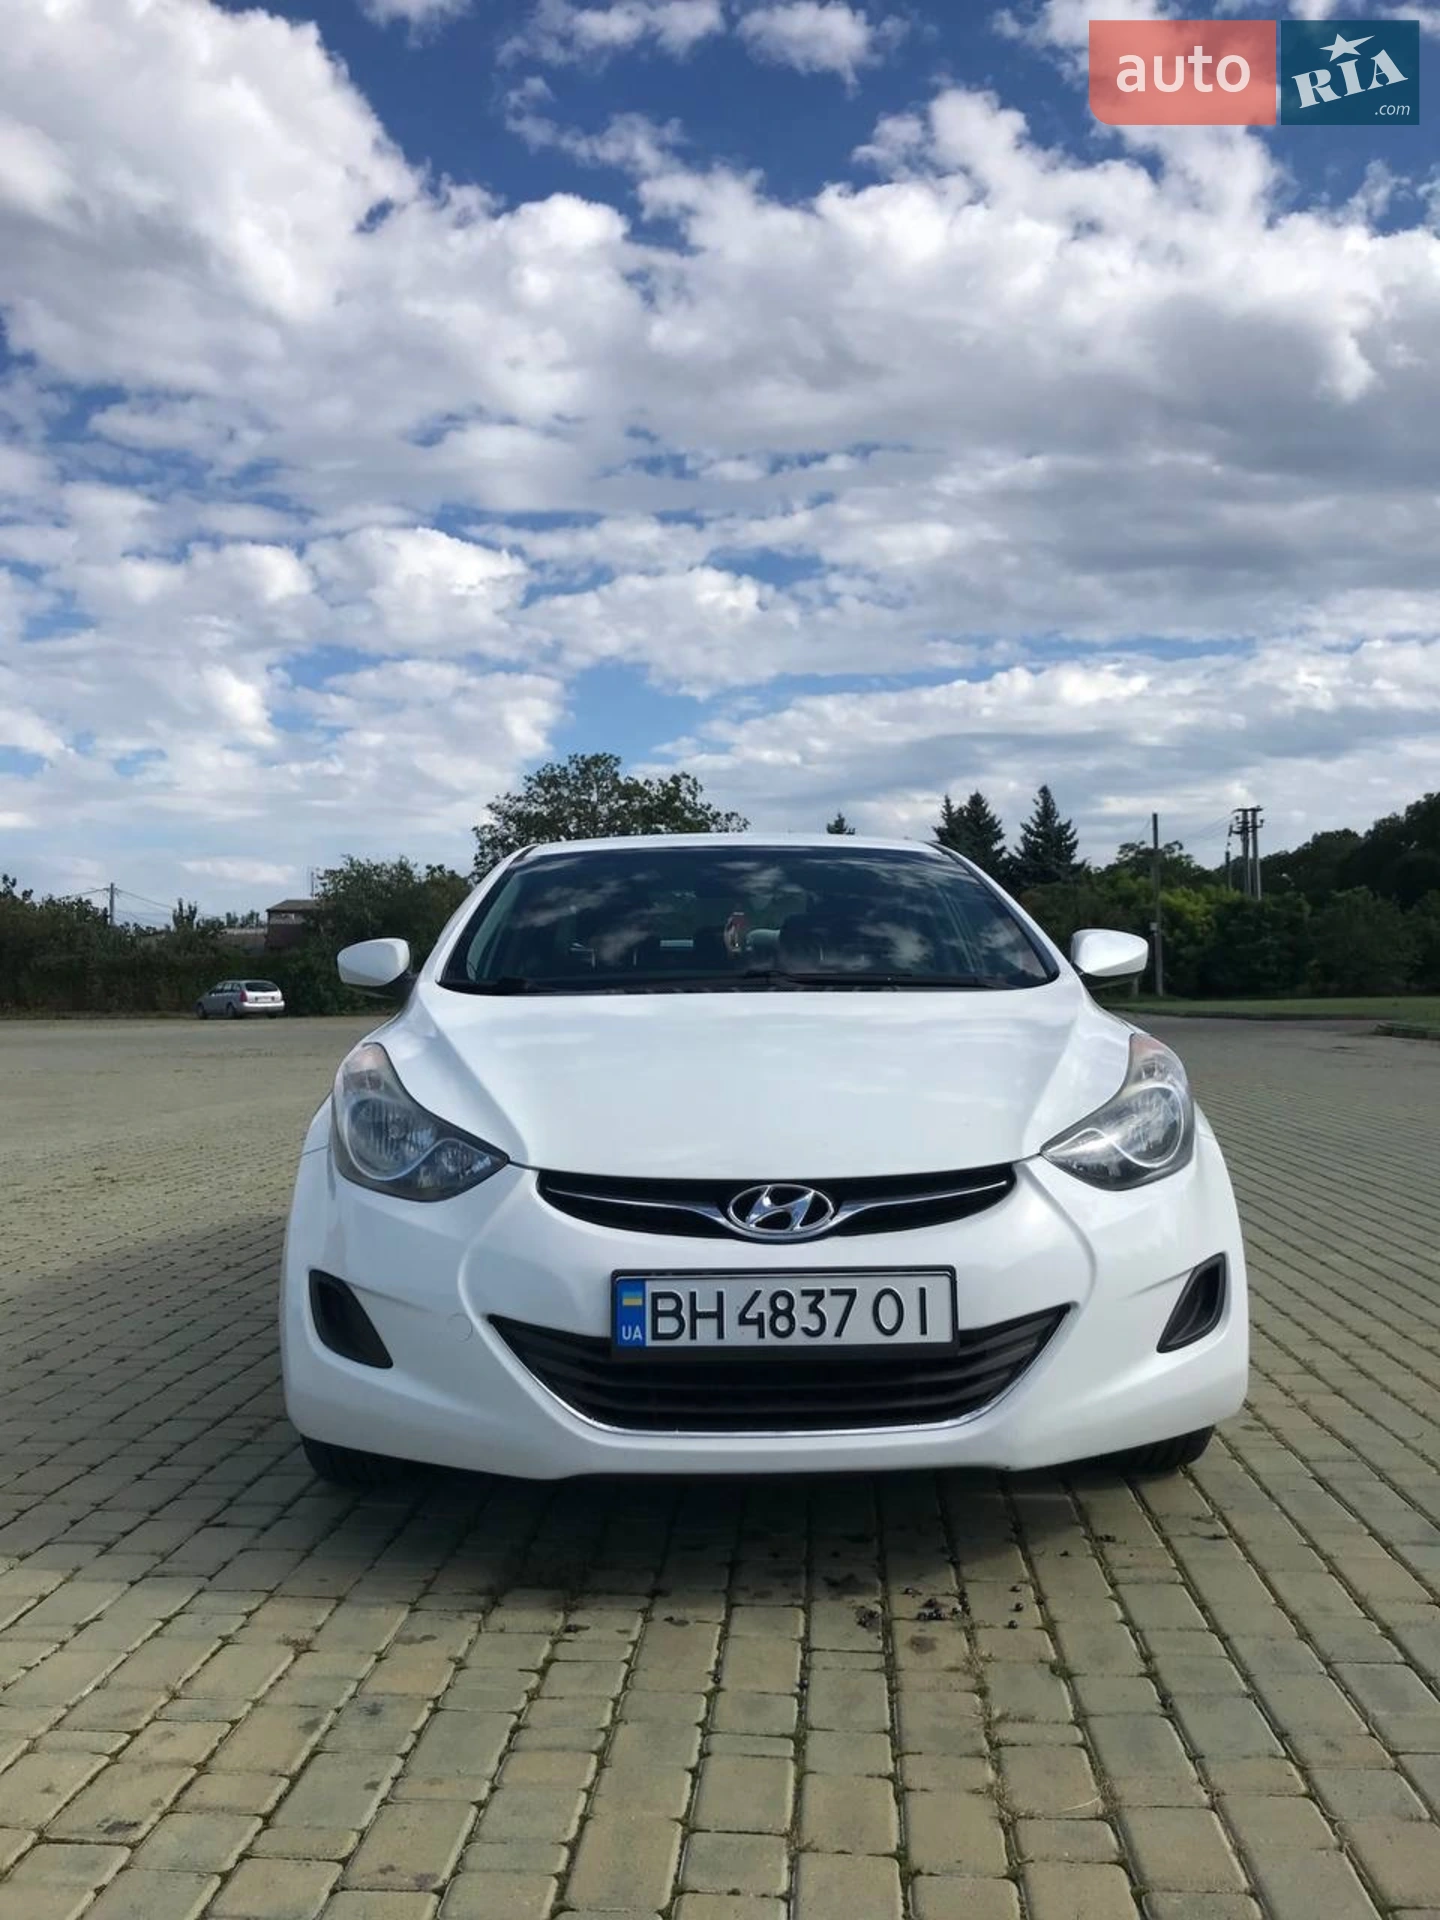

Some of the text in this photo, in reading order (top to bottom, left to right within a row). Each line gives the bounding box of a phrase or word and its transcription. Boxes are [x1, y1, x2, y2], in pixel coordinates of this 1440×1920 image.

[650, 1290, 725, 1341] BH
[737, 1287, 858, 1339] 4837
[621, 1325, 643, 1341] UA
